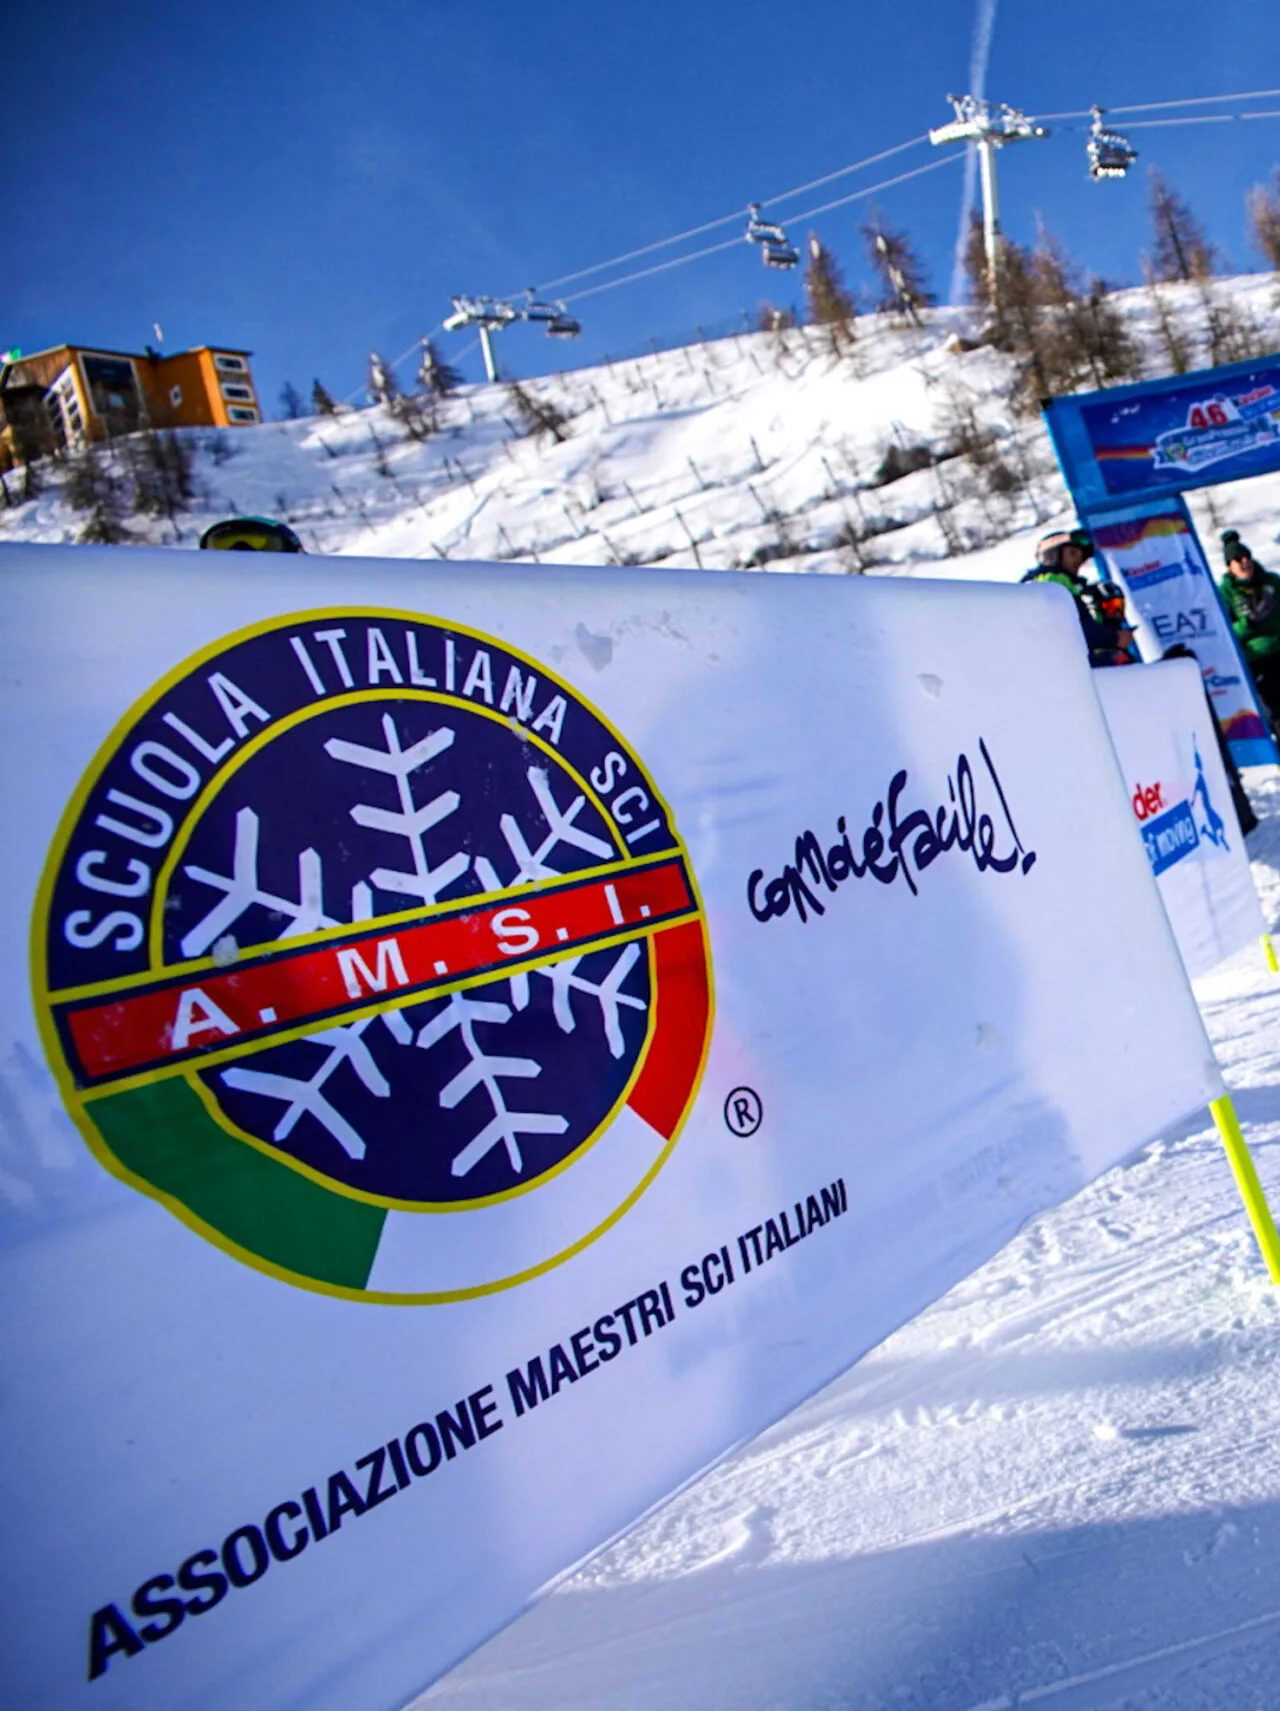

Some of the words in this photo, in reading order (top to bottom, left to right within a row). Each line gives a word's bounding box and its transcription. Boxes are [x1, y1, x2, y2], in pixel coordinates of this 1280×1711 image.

[1151, 608, 1208, 638] EA7
[63, 671, 271, 952] SCUOLA
[290, 627, 569, 746] ITALIANA
[590, 750, 661, 844] SCI
[86, 1384, 504, 1683] ASSOCIAZIONE
[505, 1281, 676, 1418] MAESTRI
[680, 1245, 736, 1309] SCI
[736, 1177, 848, 1276] ITALIANI
